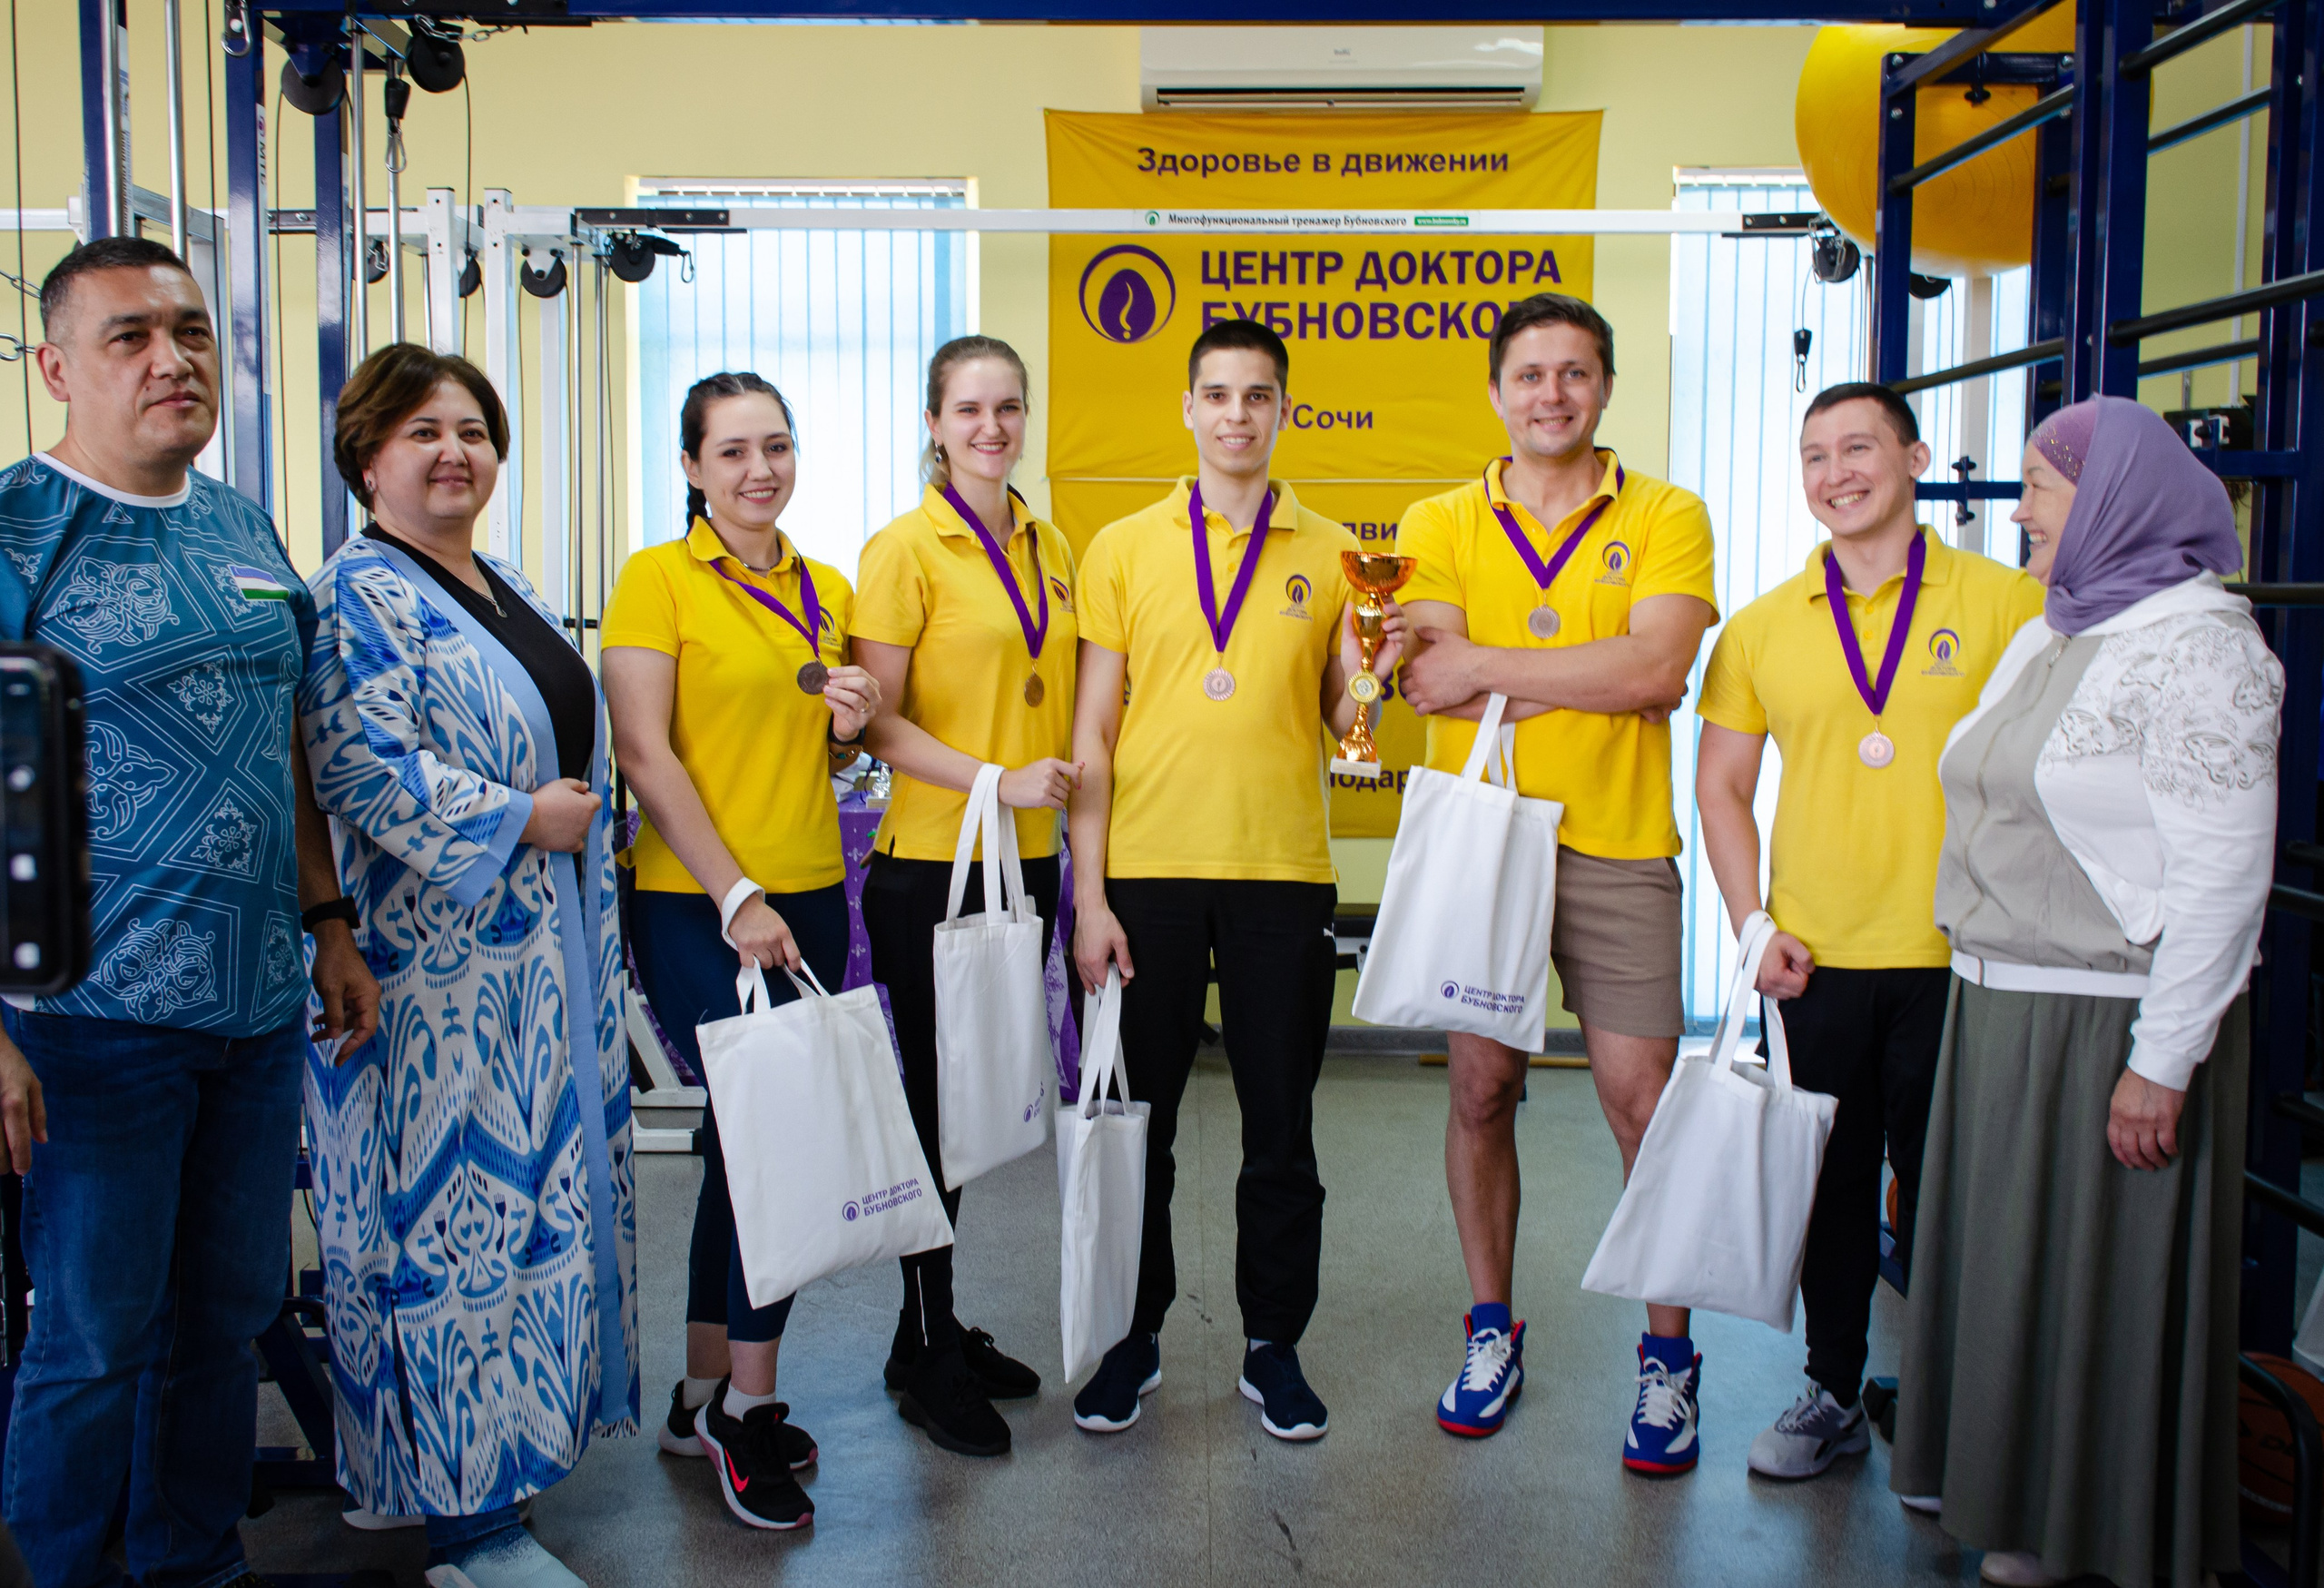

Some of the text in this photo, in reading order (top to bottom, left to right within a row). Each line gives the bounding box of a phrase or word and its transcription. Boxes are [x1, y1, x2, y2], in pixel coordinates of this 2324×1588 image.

[1137, 146, 1509, 179] Здоровье в движении
[1167, 212, 1407, 229] Многофункциональный тренажер Бубновского
[1201, 250, 1562, 292] ЦЕНТР ДОКТОРА
[1202, 301, 1522, 340] БУБНОВСКО
[1292, 403, 1374, 430] Сочи
[1460, 994, 1523, 1014] БУБНОВСКОГО
[1463, 984, 1492, 1000] ЦЕНТР
[862, 1178, 920, 1205] ЦЕНТР ДОКТОРА
[863, 1188, 922, 1217] БУБНОВСКОГО
